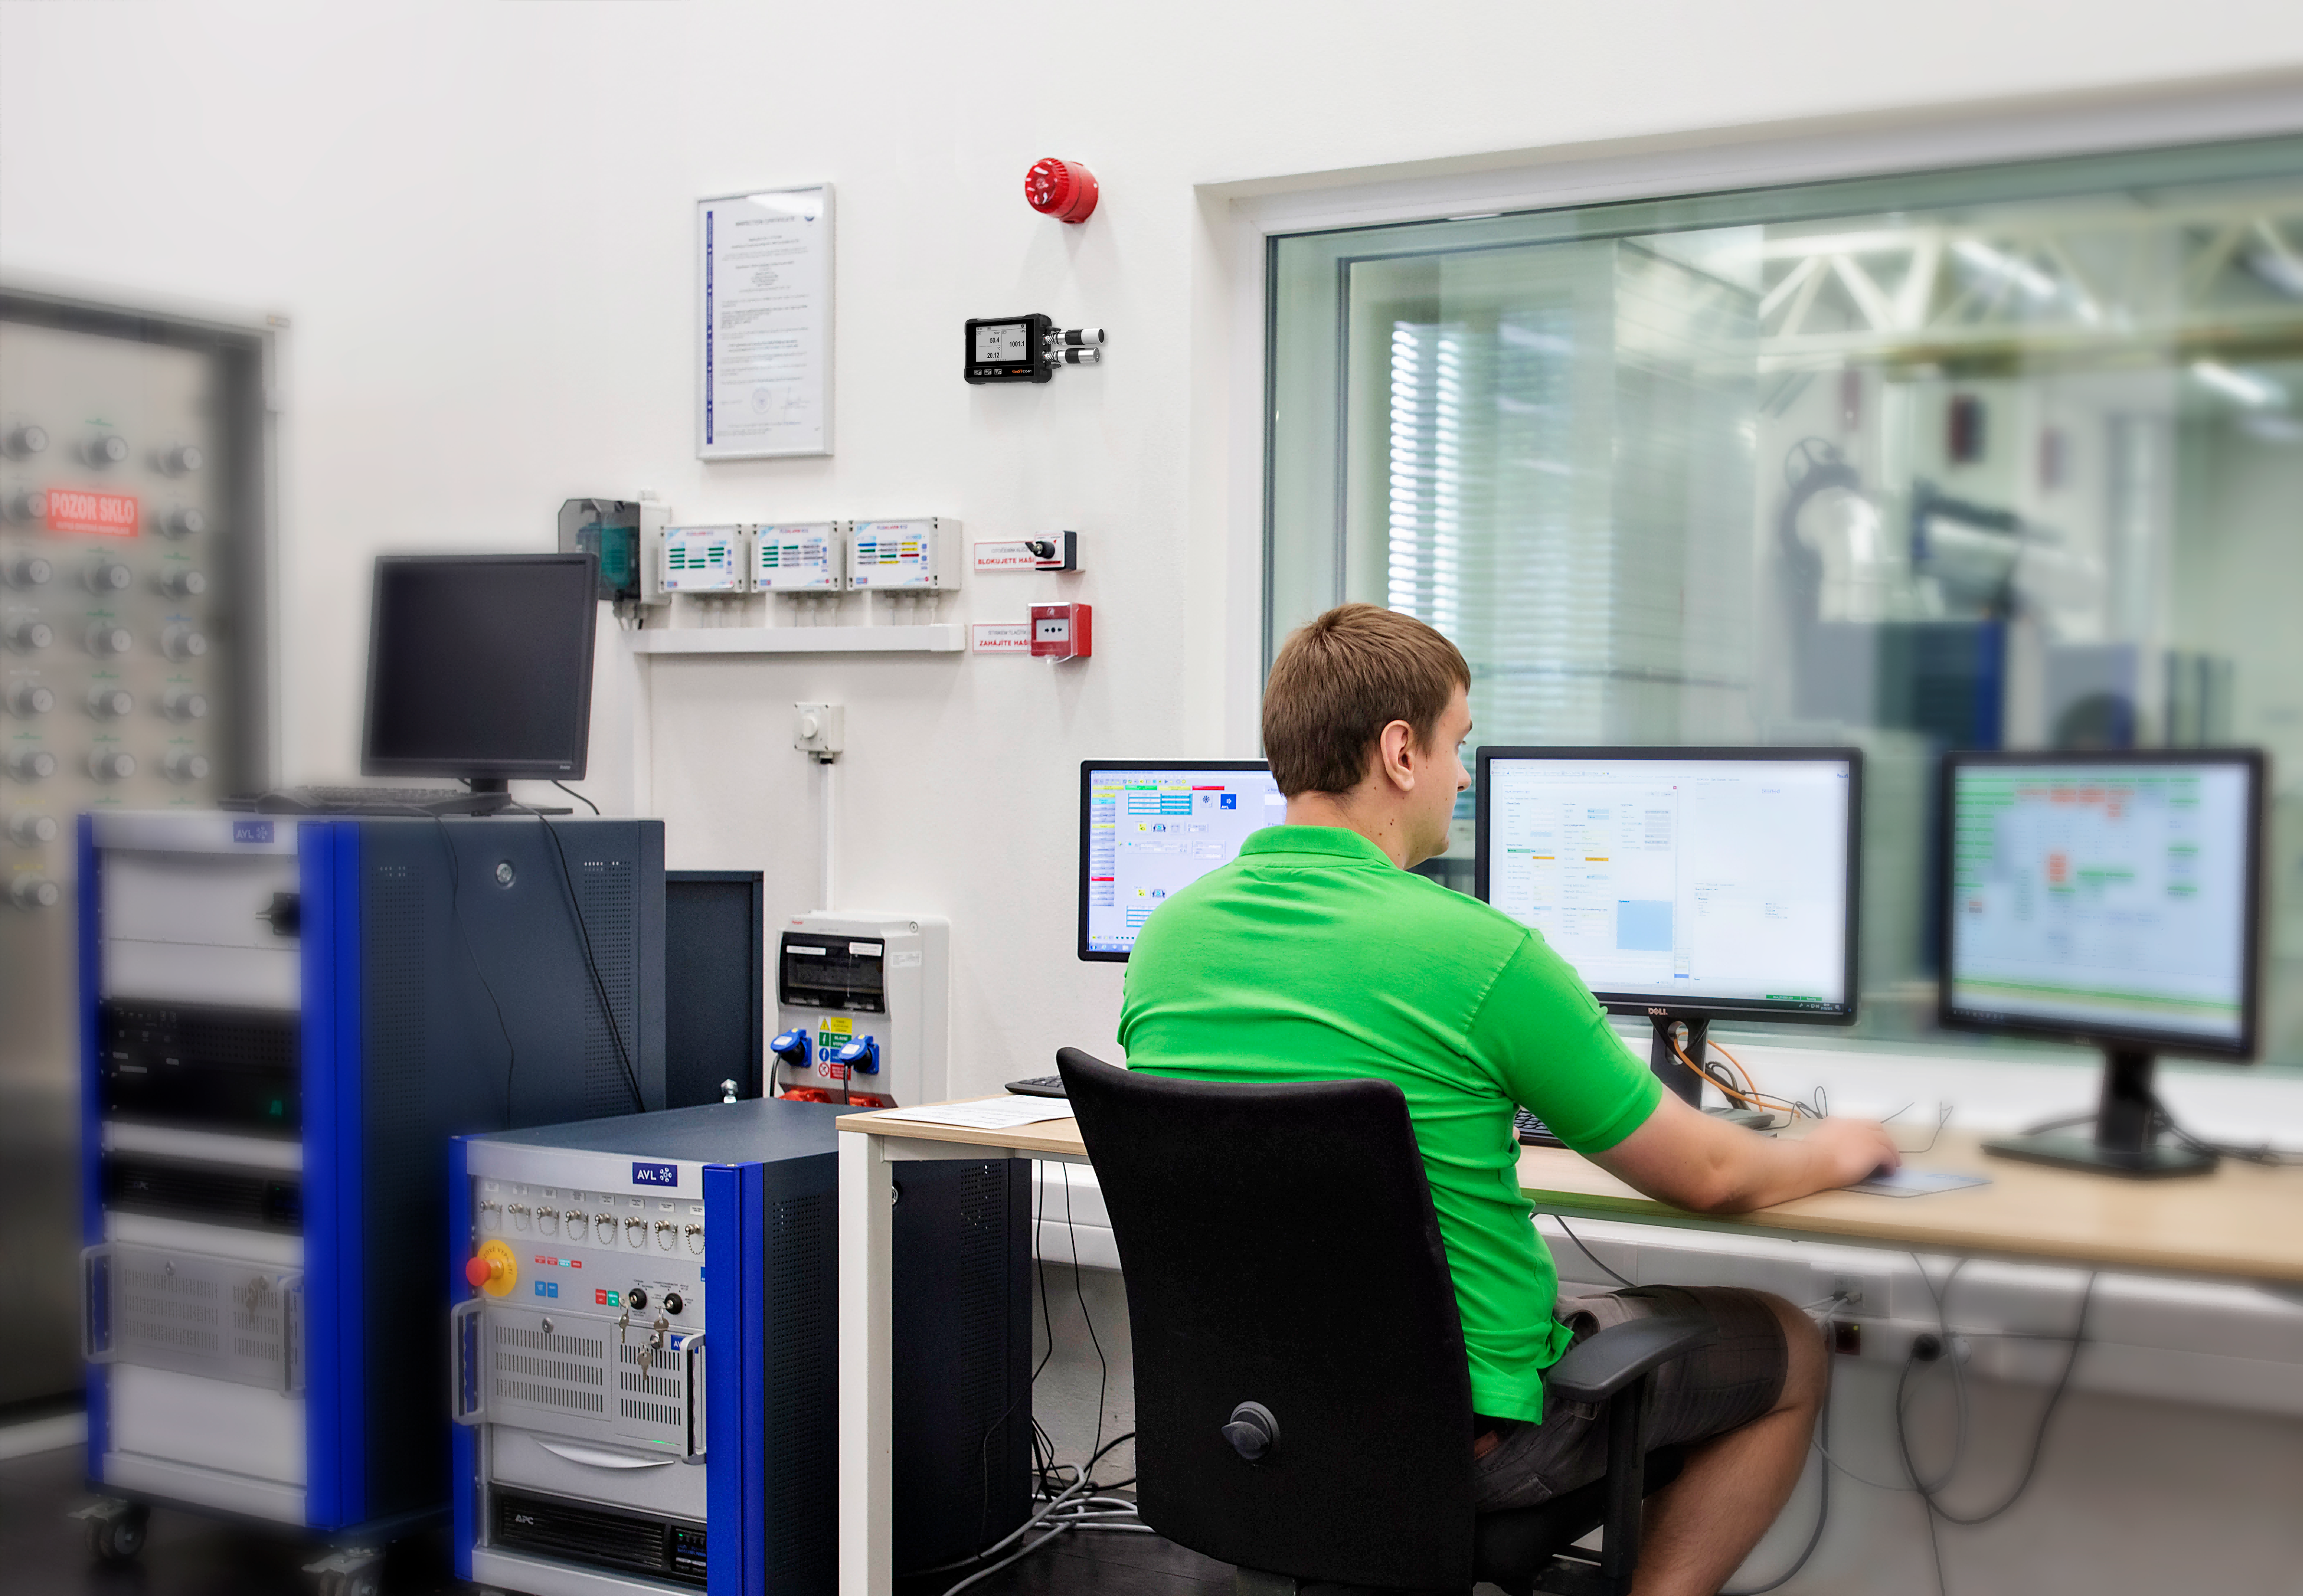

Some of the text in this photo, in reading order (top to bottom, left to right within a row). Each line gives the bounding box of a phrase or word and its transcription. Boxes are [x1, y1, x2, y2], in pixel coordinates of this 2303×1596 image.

[51, 492, 134, 524] POZOR SKLO
[978, 557, 1017, 565] BLOKUJETE
[236, 829, 254, 839] AVL
[1648, 1007, 1668, 1016] DELL
[637, 1170, 656, 1181] AVL
[515, 1514, 533, 1525] APC
